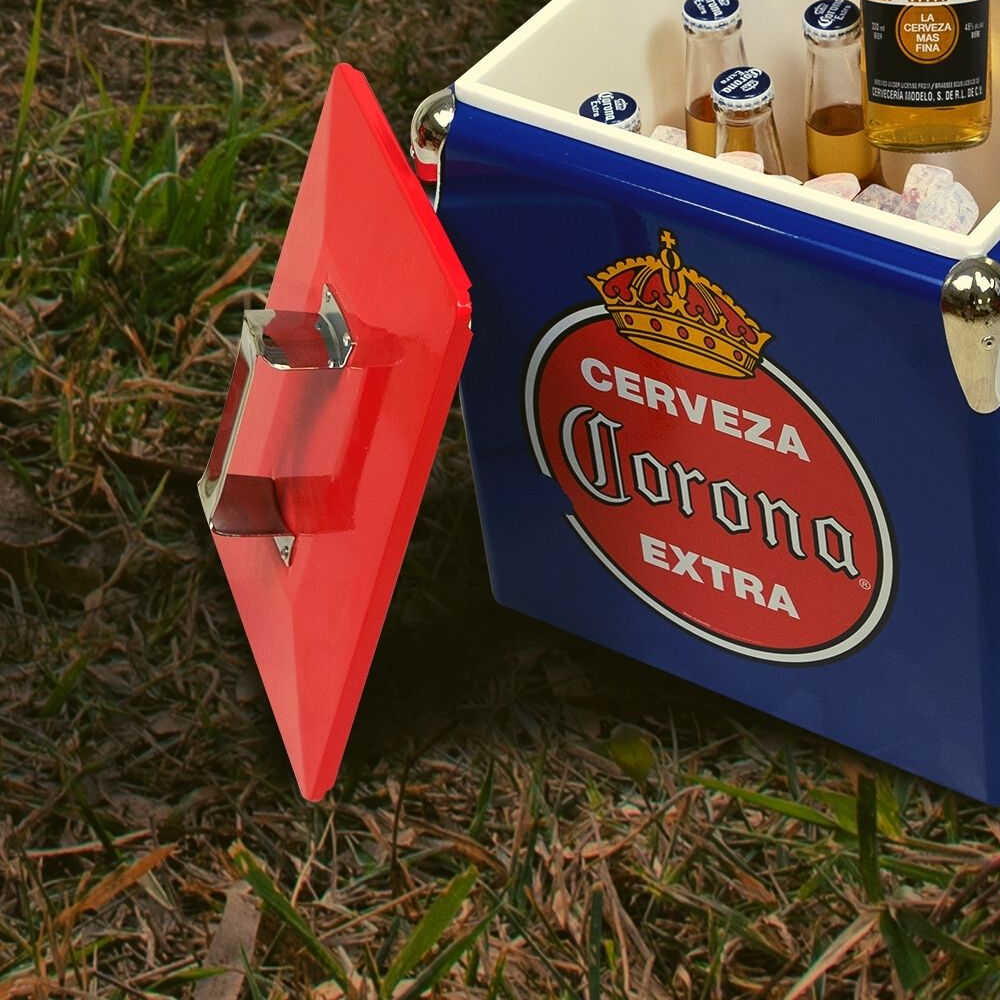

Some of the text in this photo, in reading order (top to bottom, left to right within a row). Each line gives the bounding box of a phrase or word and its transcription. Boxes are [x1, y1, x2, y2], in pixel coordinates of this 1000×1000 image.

[920, 13, 935, 22] LA
[903, 22, 952, 32] CERVEZA
[916, 33, 940, 42] MAS
[915, 43, 940, 53] FINA
[721, 68, 762, 94] Corona
[946, 91, 953, 100] DE
[580, 357, 811, 462] CERVEZA
[560, 405, 859, 578] Corona
[639, 533, 800, 619] EXTRA
